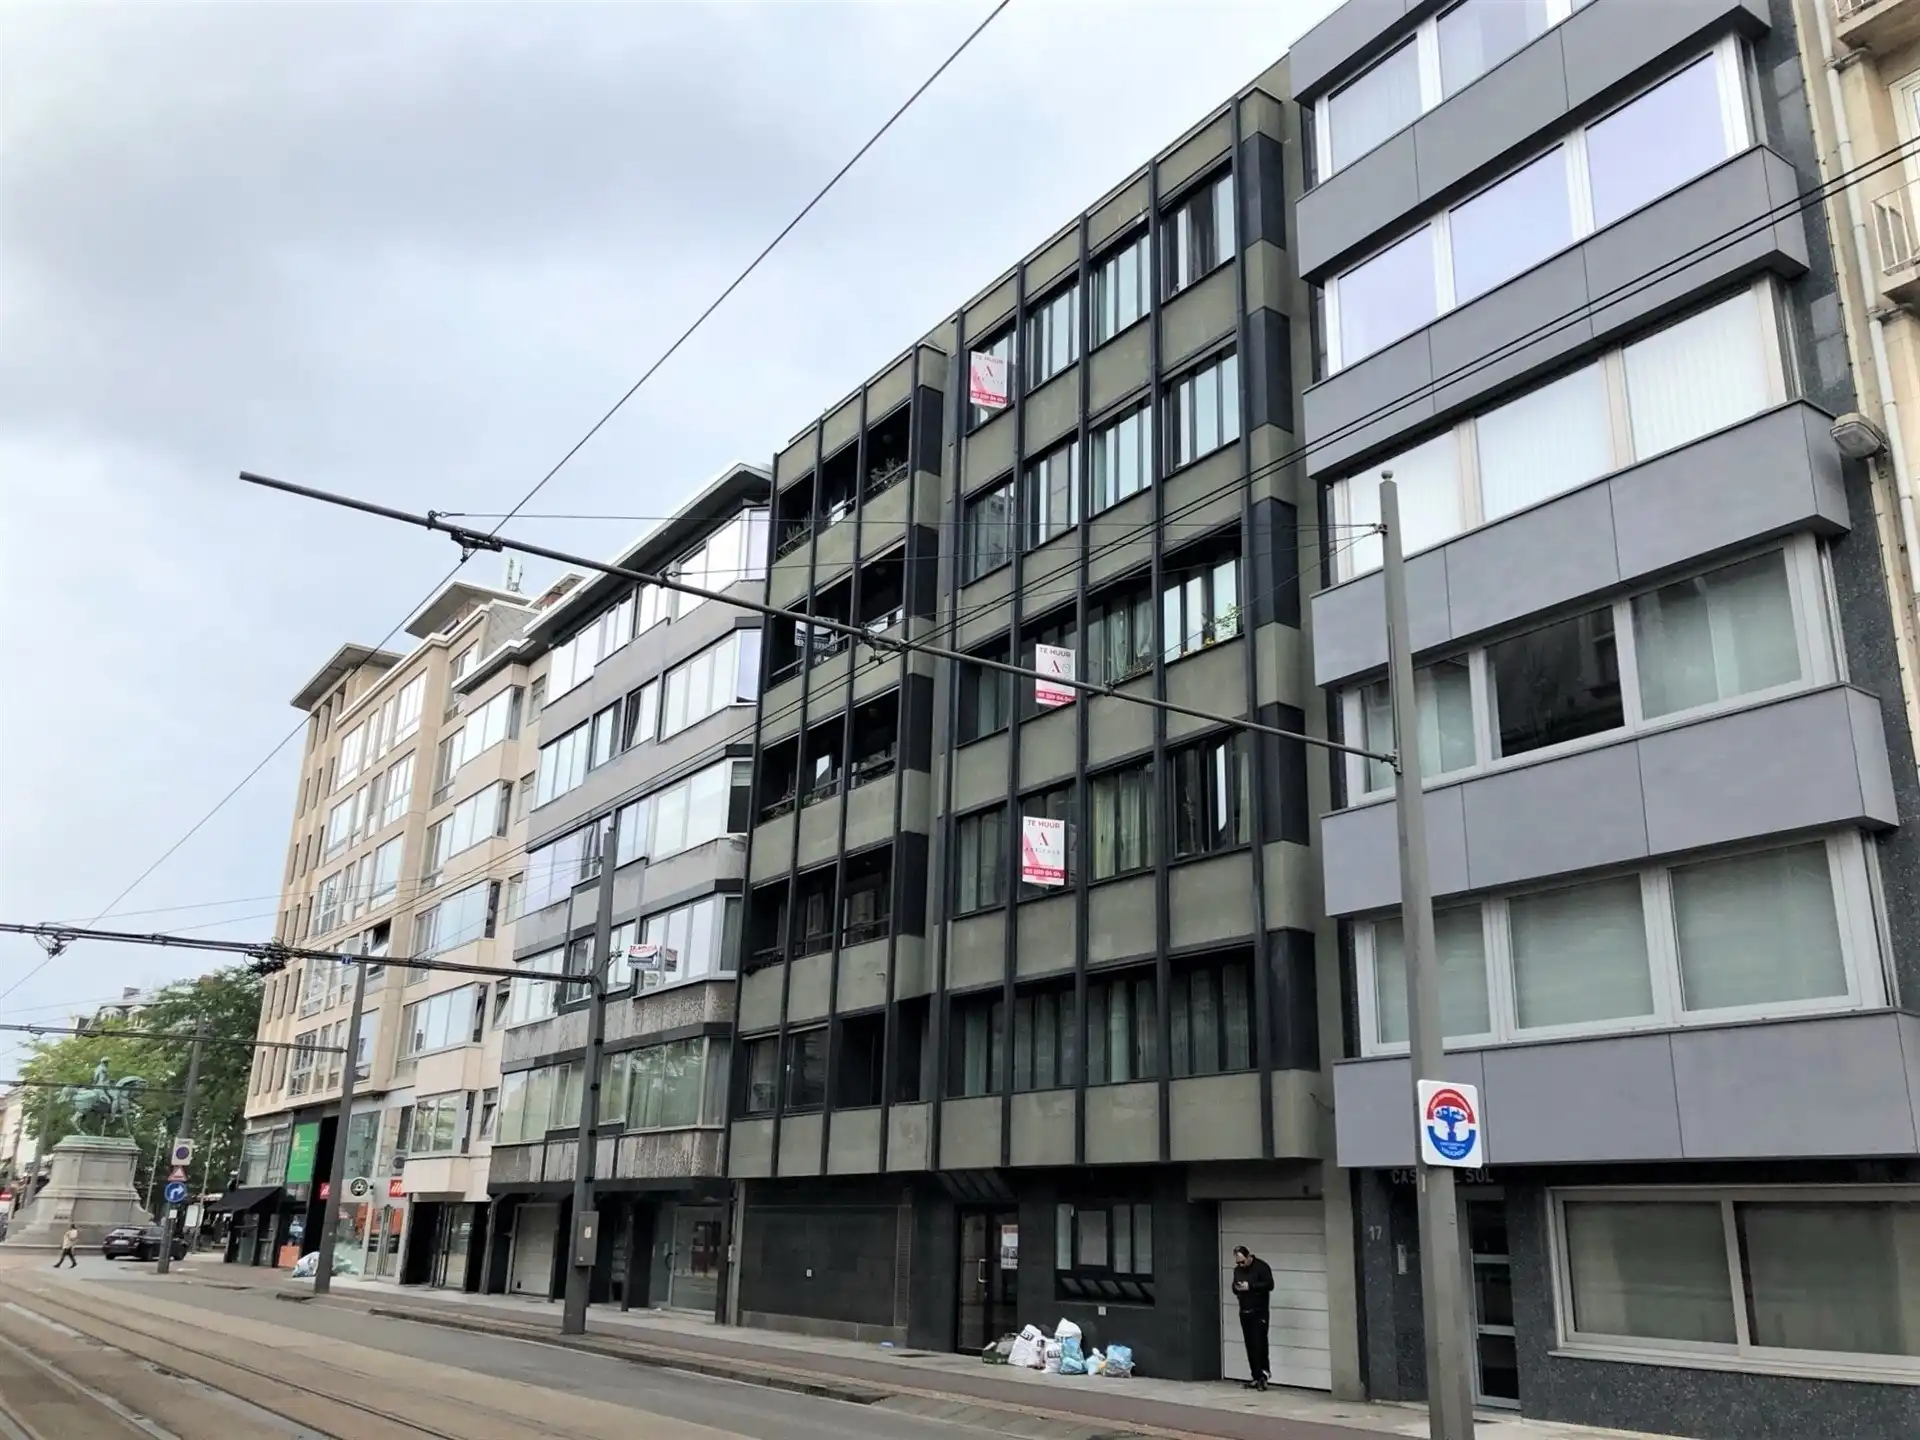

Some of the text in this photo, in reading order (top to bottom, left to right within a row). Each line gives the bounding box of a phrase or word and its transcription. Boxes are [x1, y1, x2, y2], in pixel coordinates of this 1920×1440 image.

[1050, 648, 1071, 658] HUUR
[1027, 819, 1060, 829] TE HUUR
[1392, 1170, 1418, 1184] CAS
[1465, 1167, 1495, 1184] SOL
[1369, 1225, 1383, 1241] 17
